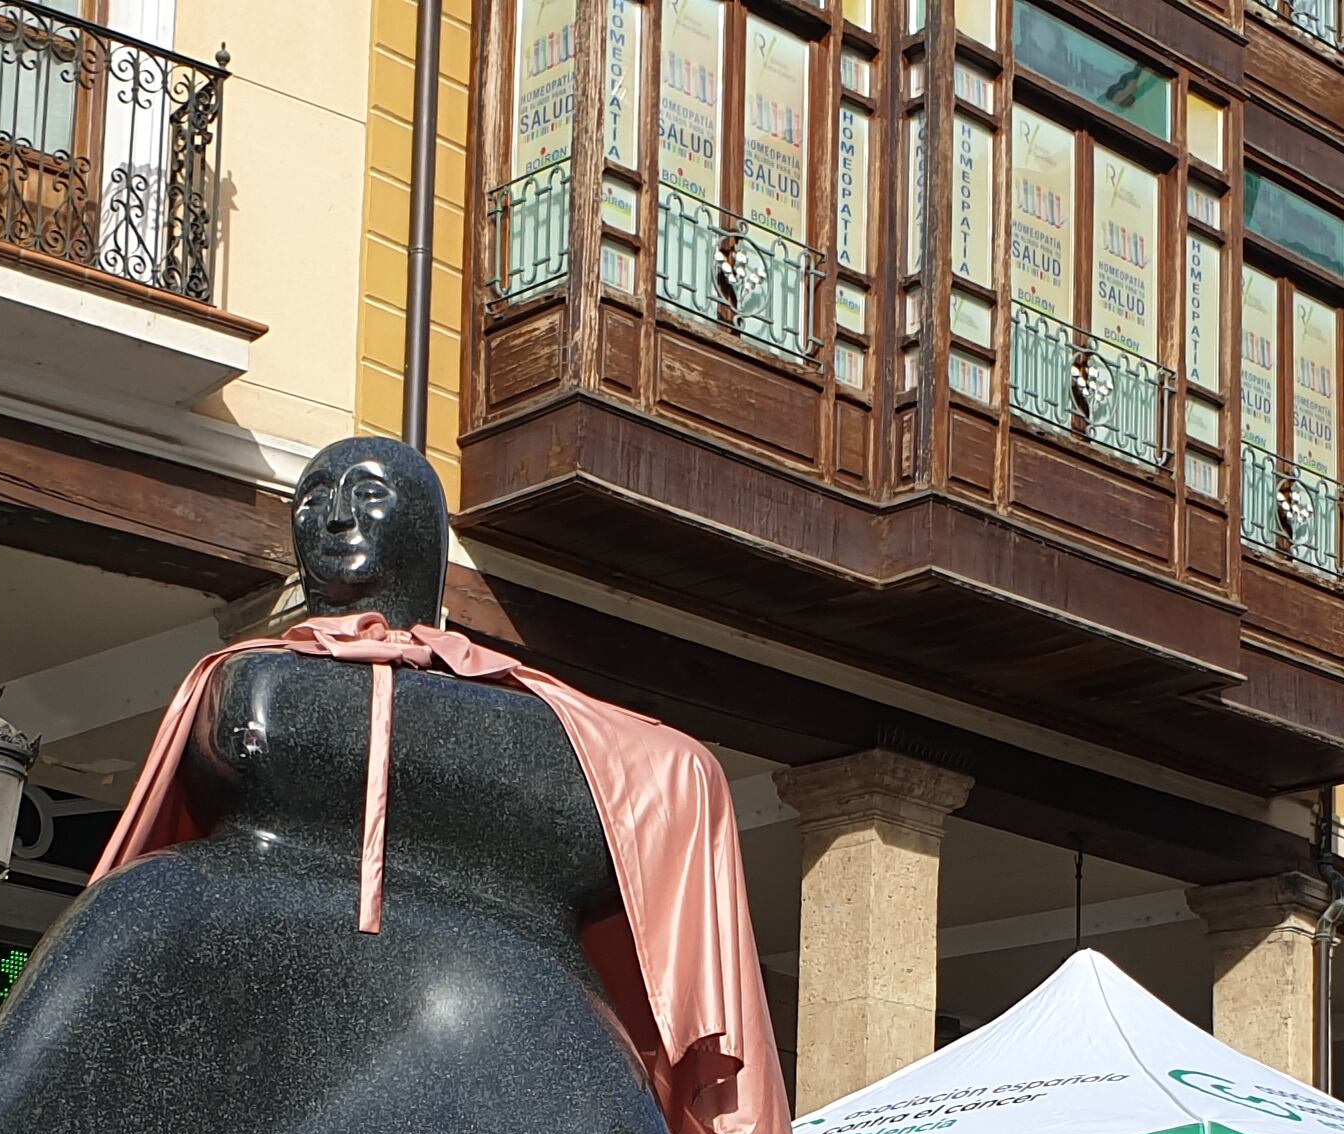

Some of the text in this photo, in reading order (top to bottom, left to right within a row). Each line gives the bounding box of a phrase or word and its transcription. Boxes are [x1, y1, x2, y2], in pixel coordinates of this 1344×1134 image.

[520, 93, 575, 135] SALUD
[745, 158, 801, 200] SALUD
[840, 111, 855, 264] HOMEOPATÍA
[959, 125, 974, 277] HOMEOPATÍA
[751, 211, 794, 237] BOIRON
[1012, 240, 1062, 278] SALUD
[1098, 282, 1145, 316] SALUD
[1189, 240, 1203, 382] HOMEOPATÍA
[1104, 327, 1140, 352] BOIRON
[1241, 387, 1272, 415] ALUD
[1294, 411, 1332, 443] SALUD
[843, 1072, 1132, 1122] asociación española
[913, 1104, 946, 1122] el
[949, 1091, 1051, 1116] cáncer
